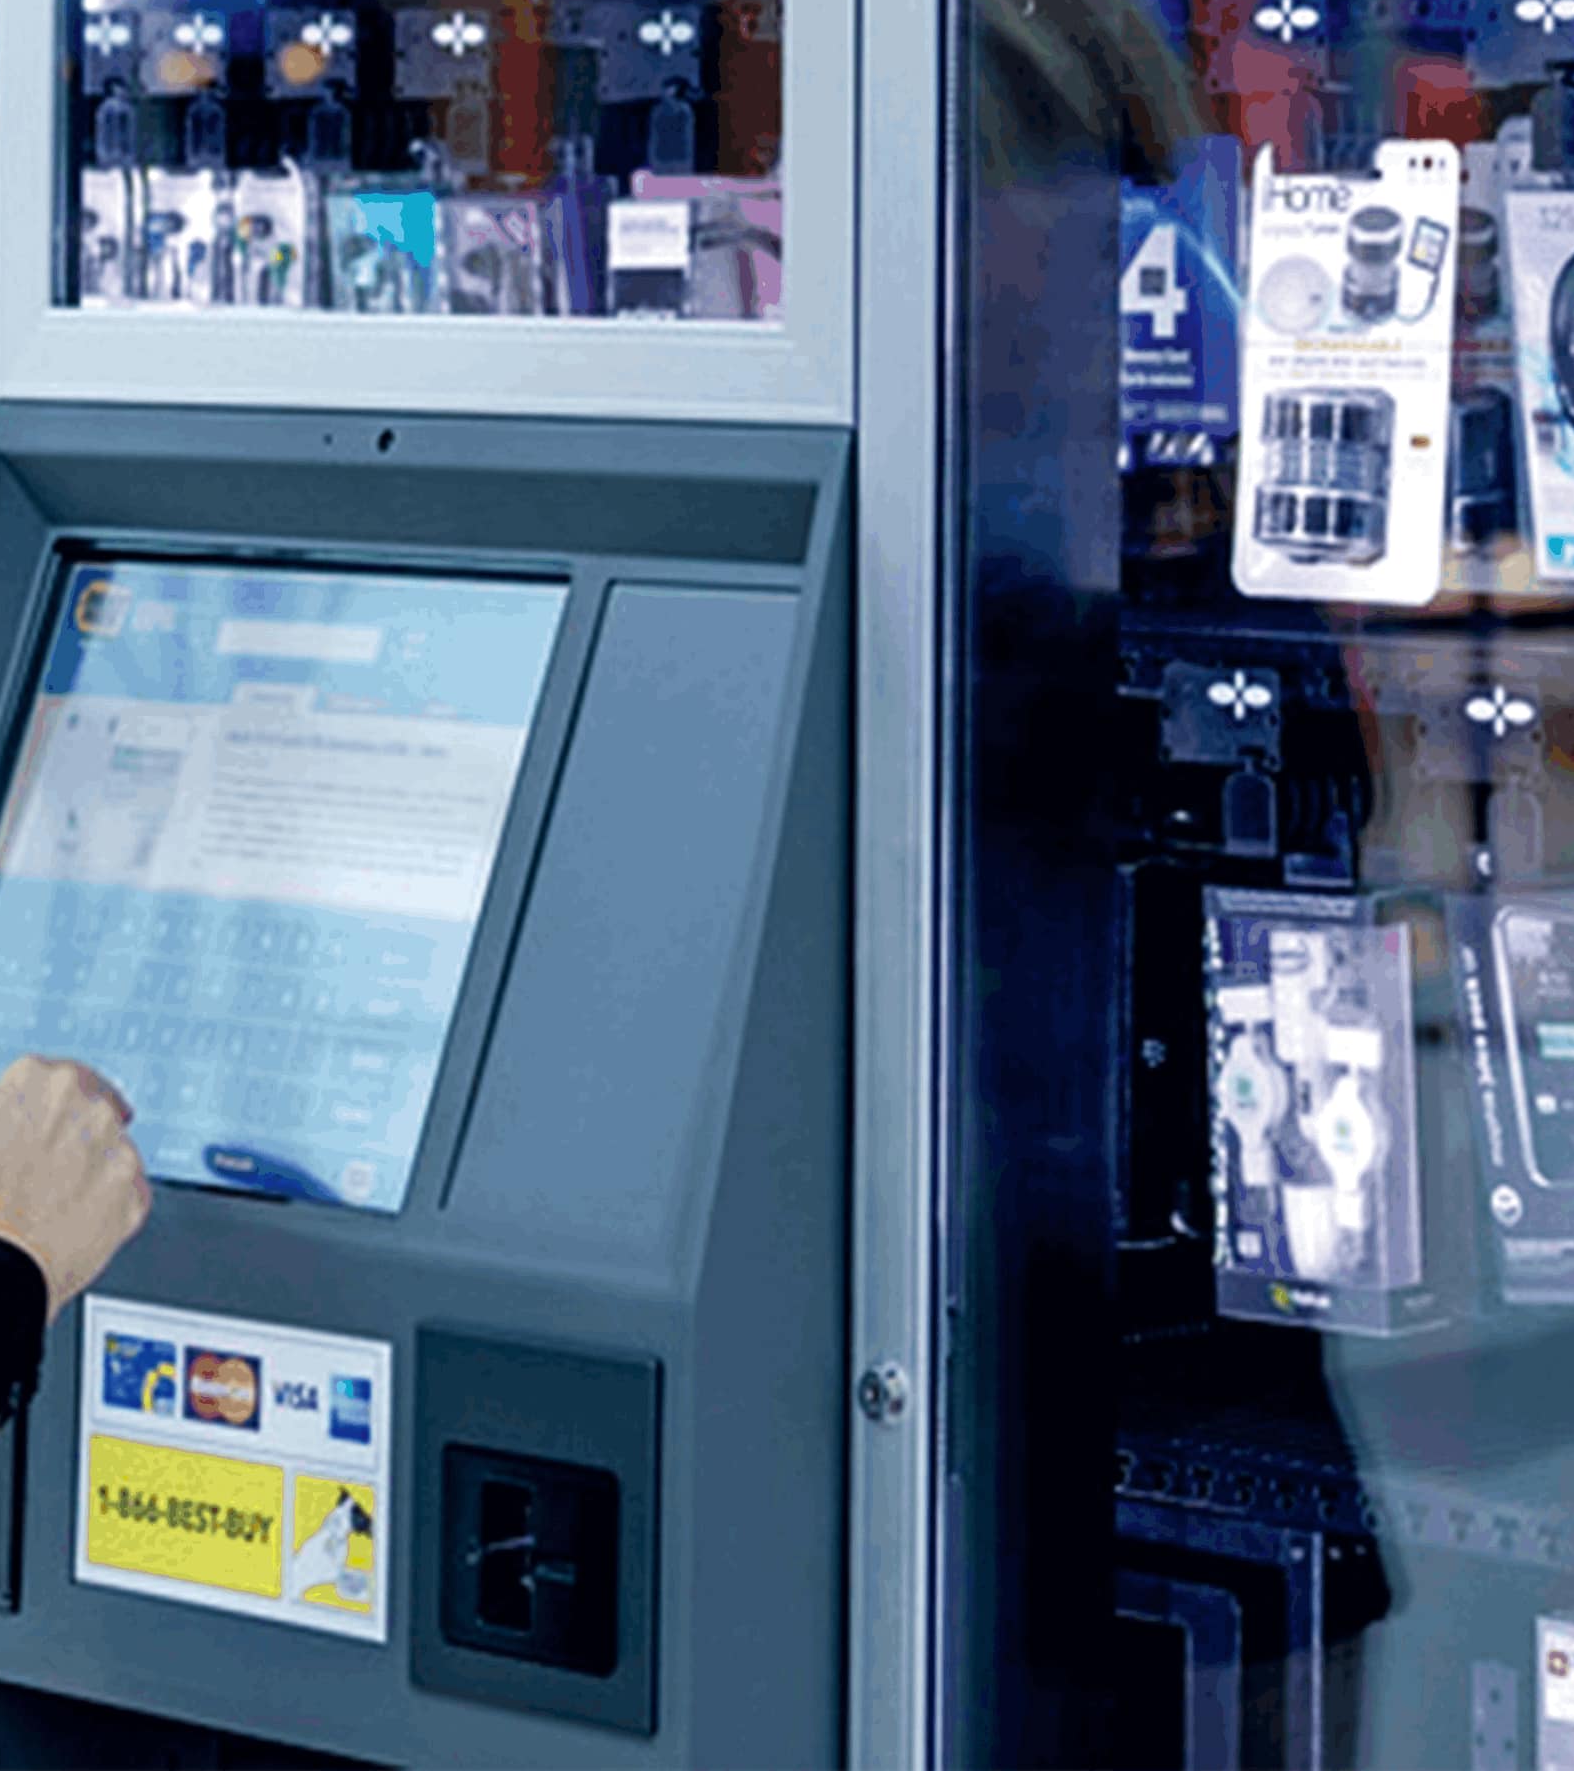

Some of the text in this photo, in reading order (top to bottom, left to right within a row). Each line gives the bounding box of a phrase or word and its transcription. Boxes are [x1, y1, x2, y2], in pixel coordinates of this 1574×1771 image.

[1119, 223, 1188, 339] 4
[272, 1378, 319, 1411] VISA
[98, 1484, 275, 1544] 1-866-BEST-BUY
